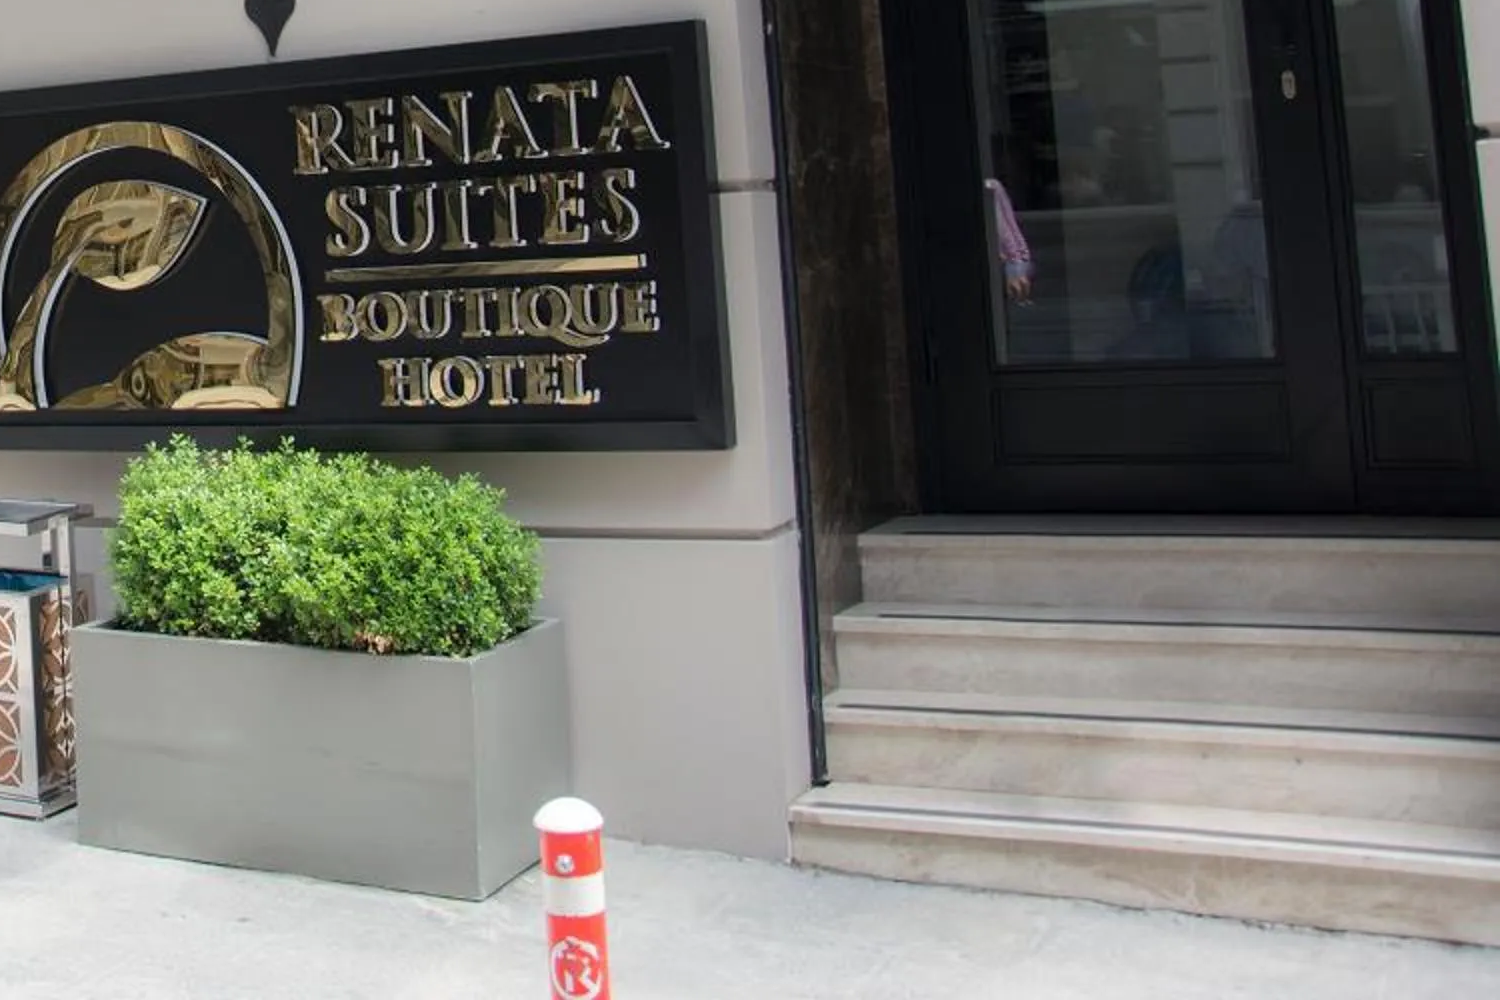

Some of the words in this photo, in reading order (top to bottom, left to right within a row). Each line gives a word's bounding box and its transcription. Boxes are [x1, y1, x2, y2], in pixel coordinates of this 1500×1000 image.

[287, 75, 671, 175] RENATA
[325, 168, 641, 258] SUITES
[316, 280, 660, 348] BOUTIQUE
[376, 352, 600, 408] HOTEL
